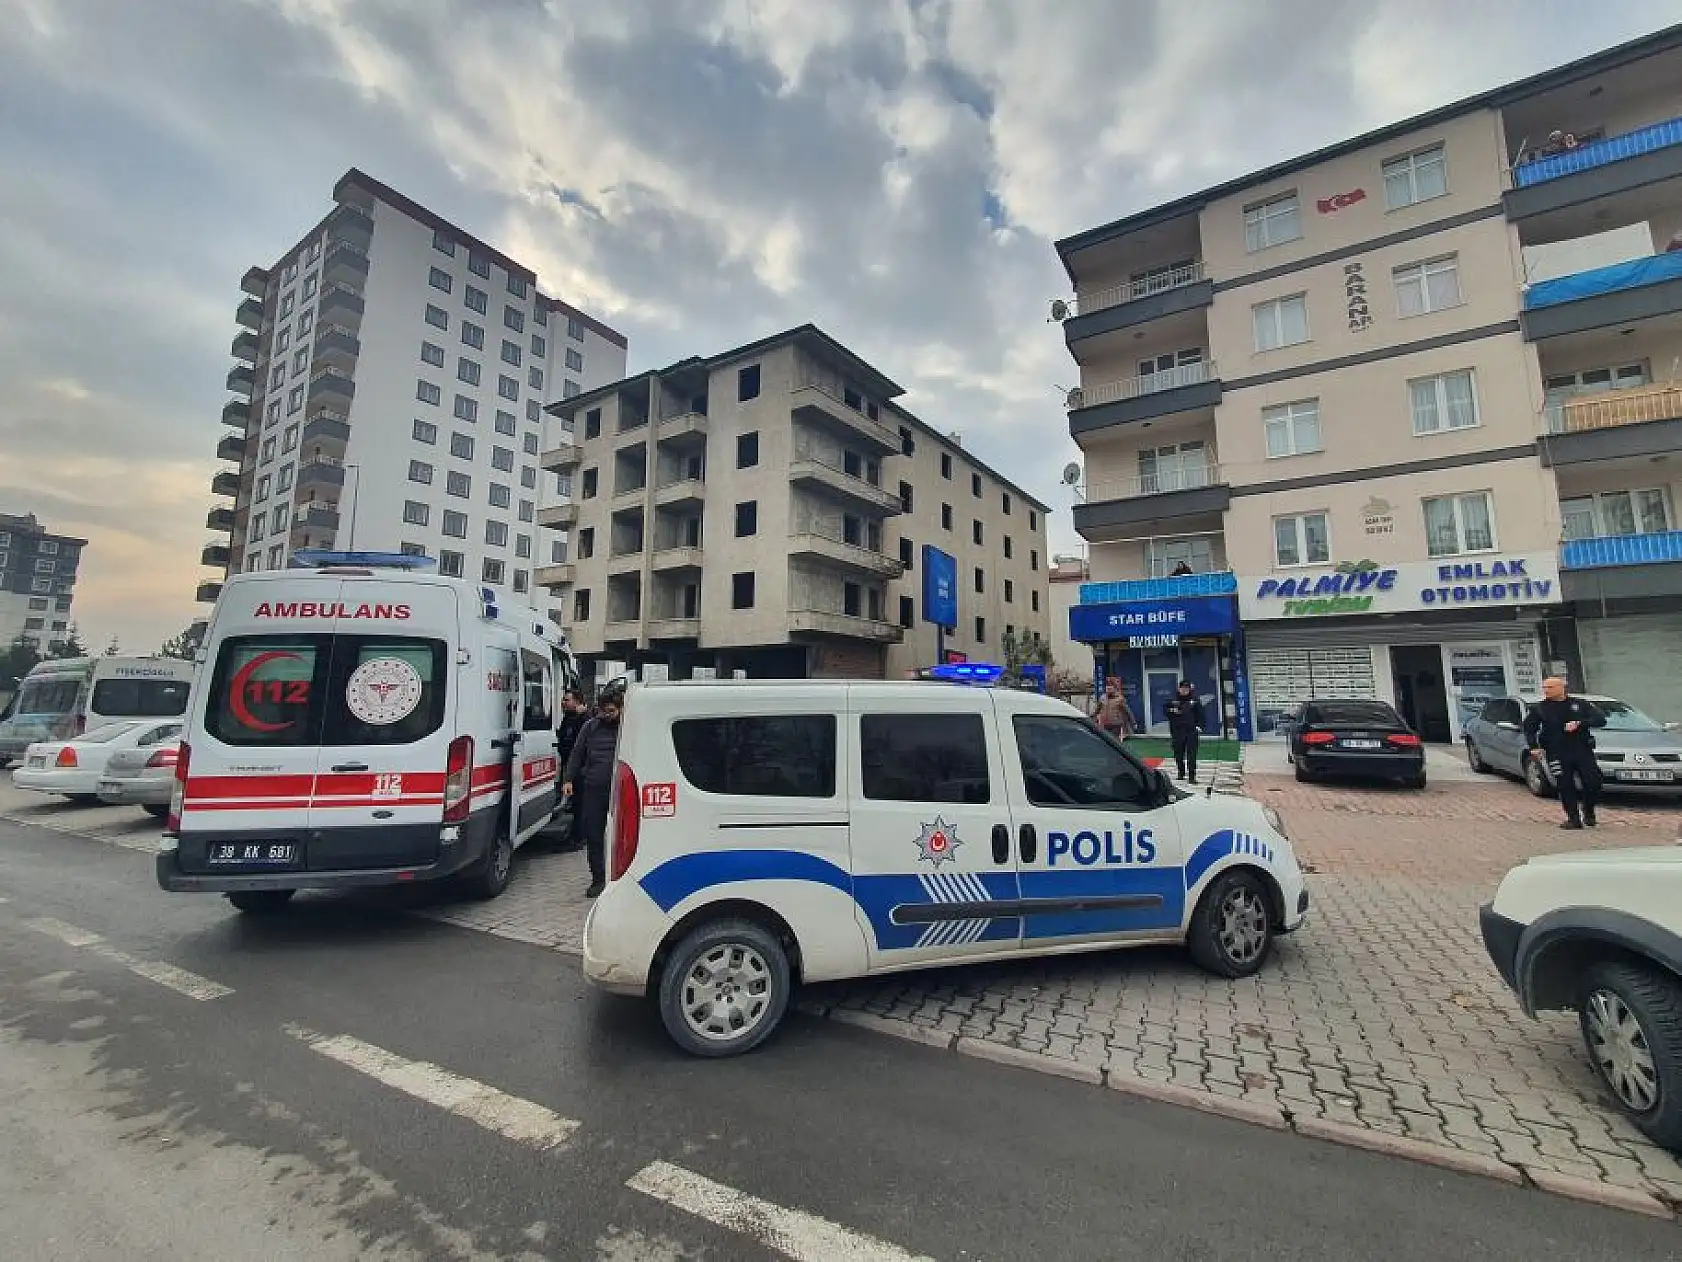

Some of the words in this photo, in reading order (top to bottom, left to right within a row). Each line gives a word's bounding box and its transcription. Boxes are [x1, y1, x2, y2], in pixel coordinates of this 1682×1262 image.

[1438, 559, 1527, 581] EMLAK
[1421, 578, 1552, 603] OTOMOTİV
[254, 602, 411, 619] AMBULANS
[1109, 613, 1144, 626] STAR
[1147, 610, 1186, 623] BÜFE
[247, 680, 310, 704] 112
[375, 774, 402, 790] 112
[647, 786, 671, 804] 112
[219, 845, 235, 858] 38
[244, 845, 260, 858] KK
[1047, 820, 1156, 866] POLİS
